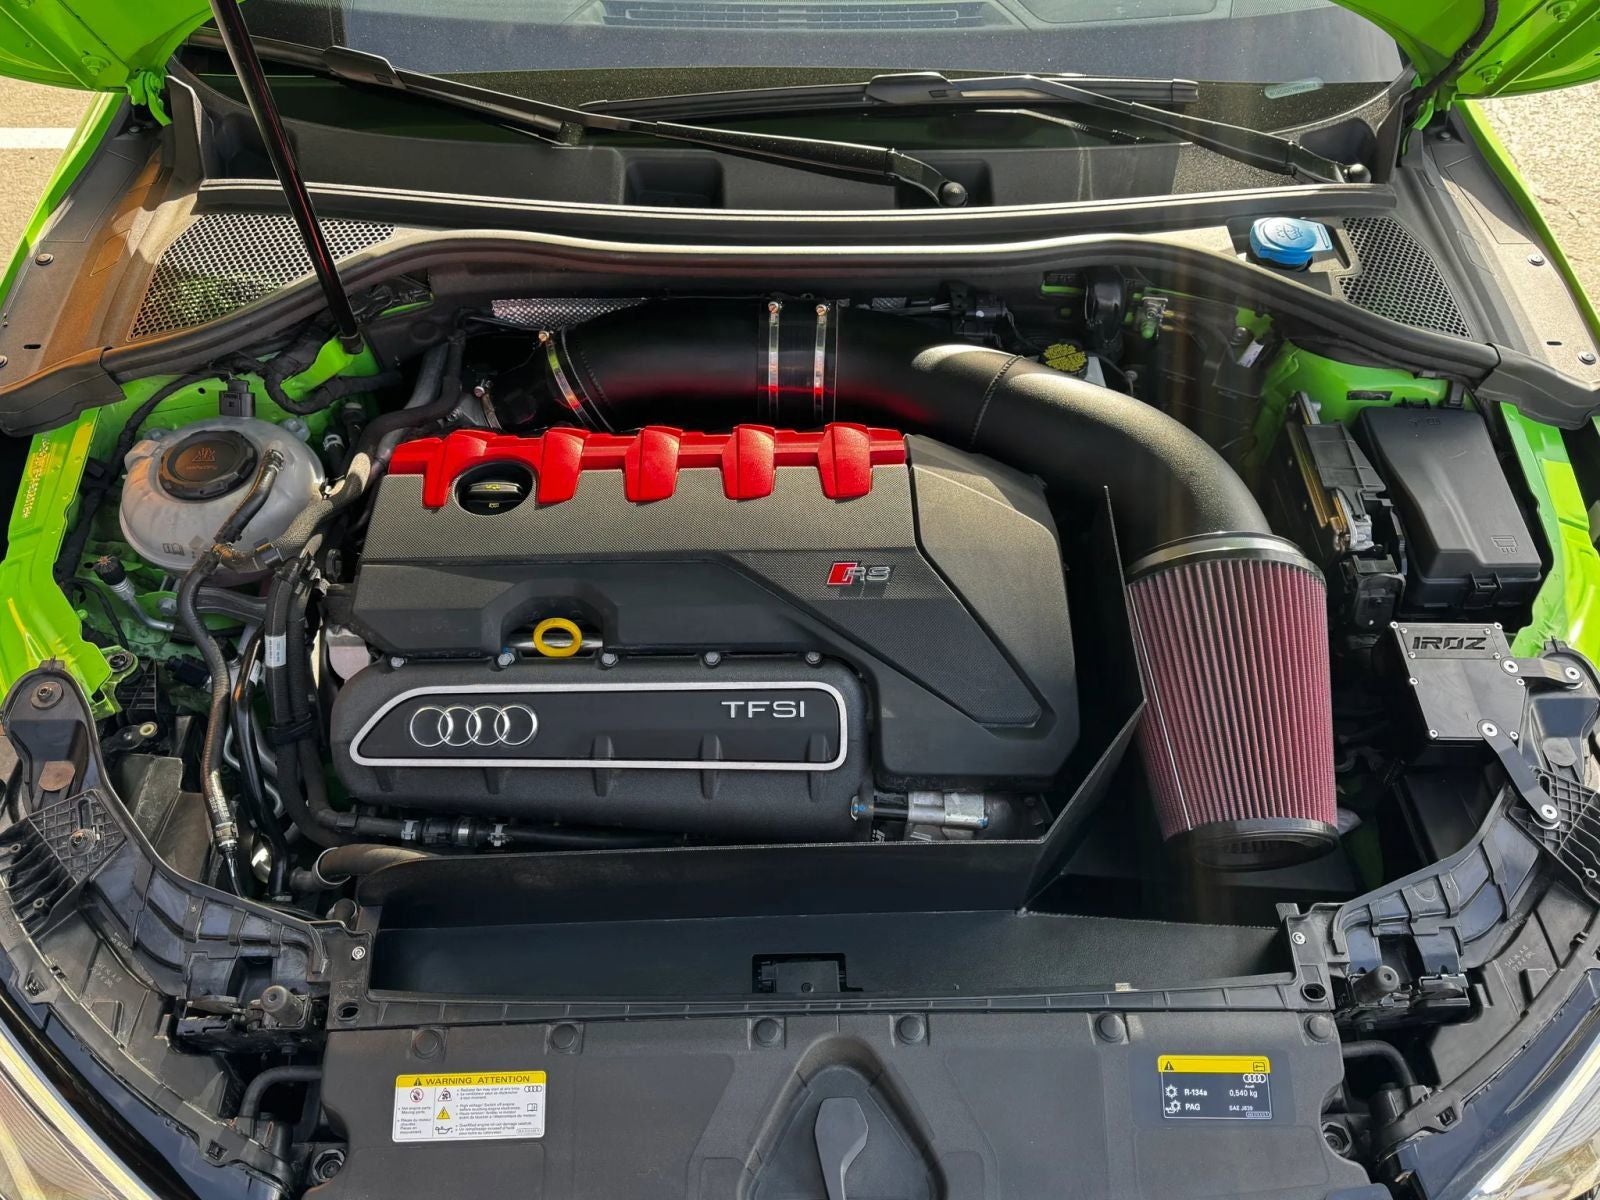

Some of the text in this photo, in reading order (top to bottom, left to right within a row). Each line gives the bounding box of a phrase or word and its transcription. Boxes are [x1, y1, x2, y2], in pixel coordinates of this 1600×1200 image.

[836, 564, 891, 583] RS
[1412, 636, 1487, 650] IROZ
[721, 700, 805, 718] TFSI
[425, 1075, 530, 1085] WARNING ATTENTION
[1184, 1088, 1208, 1096] R-134a
[1249, 1088, 1258, 1098] kg
[1185, 1103, 1201, 1111] PAG
